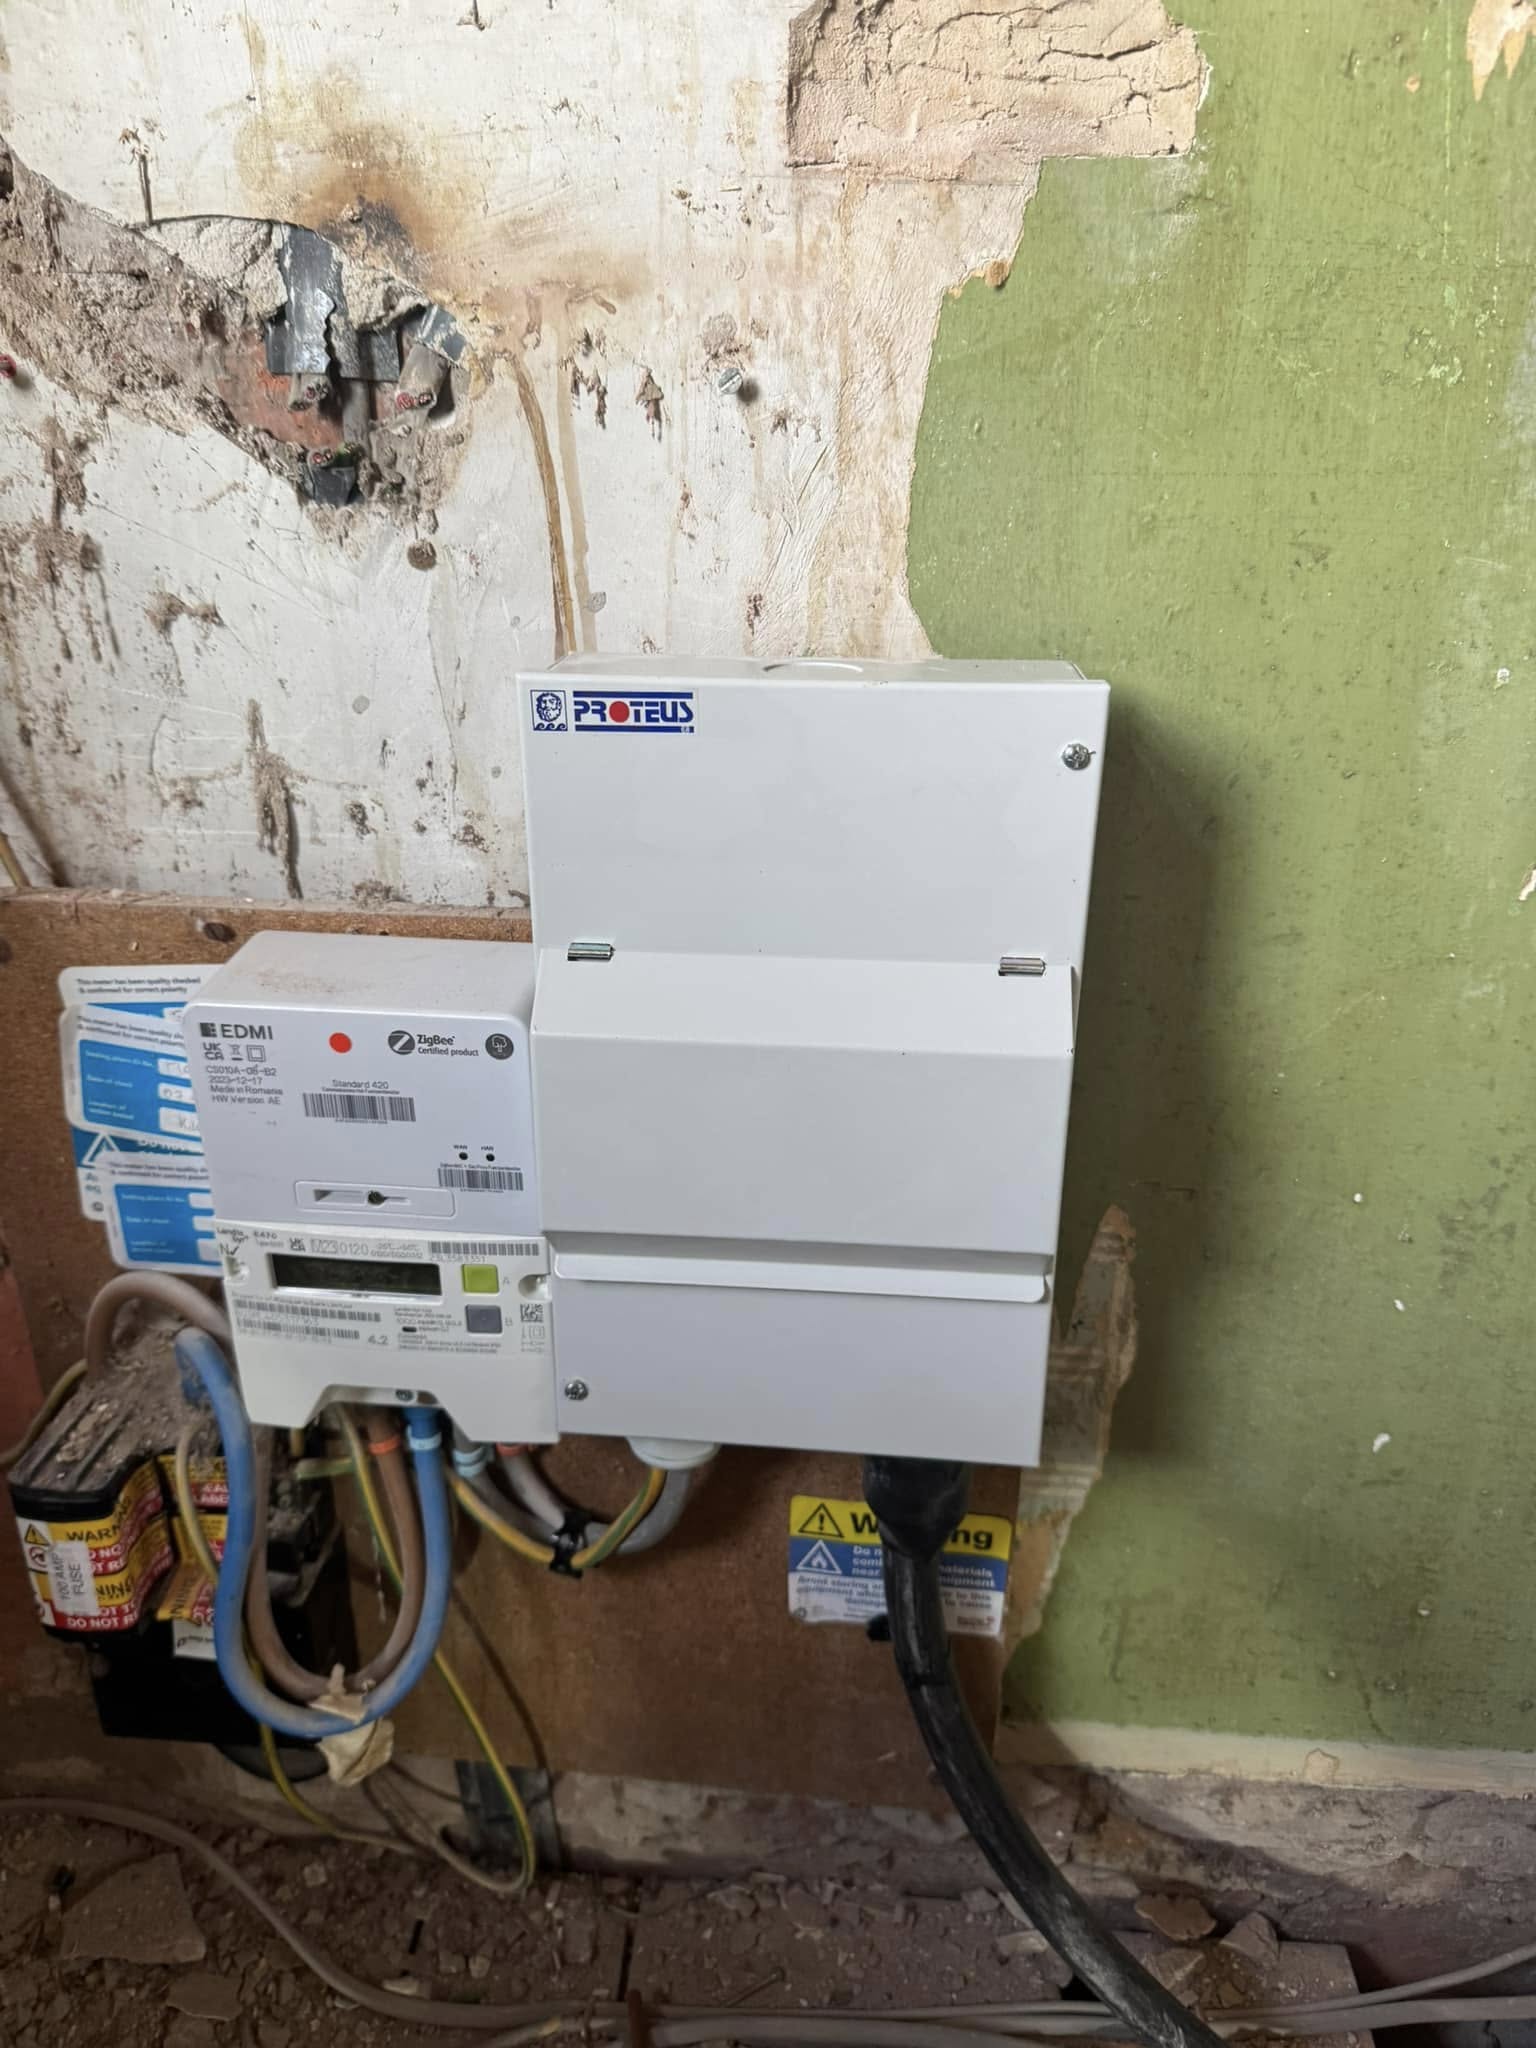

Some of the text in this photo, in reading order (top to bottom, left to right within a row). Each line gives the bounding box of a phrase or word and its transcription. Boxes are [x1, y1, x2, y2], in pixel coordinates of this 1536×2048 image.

[573, 700, 694, 724] PROTEUS
[220, 1023, 273, 1040] EDMI
[416, 1034, 454, 1046] ZigBee
[202, 1042, 221, 1051] UK
[417, 1047, 479, 1056] Certified product
[204, 1051, 224, 1060] CA
[332, 1079, 389, 1090] Standard 420
[210, 1085, 235, 1093] Made
[245, 1086, 283, 1096] Romania
[212, 1095, 228, 1103] HW
[231, 1096, 265, 1104] Version
[852, 1544, 871, 1555] Do
[51, 1552, 66, 1579] AMP
[68, 1563, 85, 1595] FUSE
[67, 1616, 119, 1627] DO NOT
